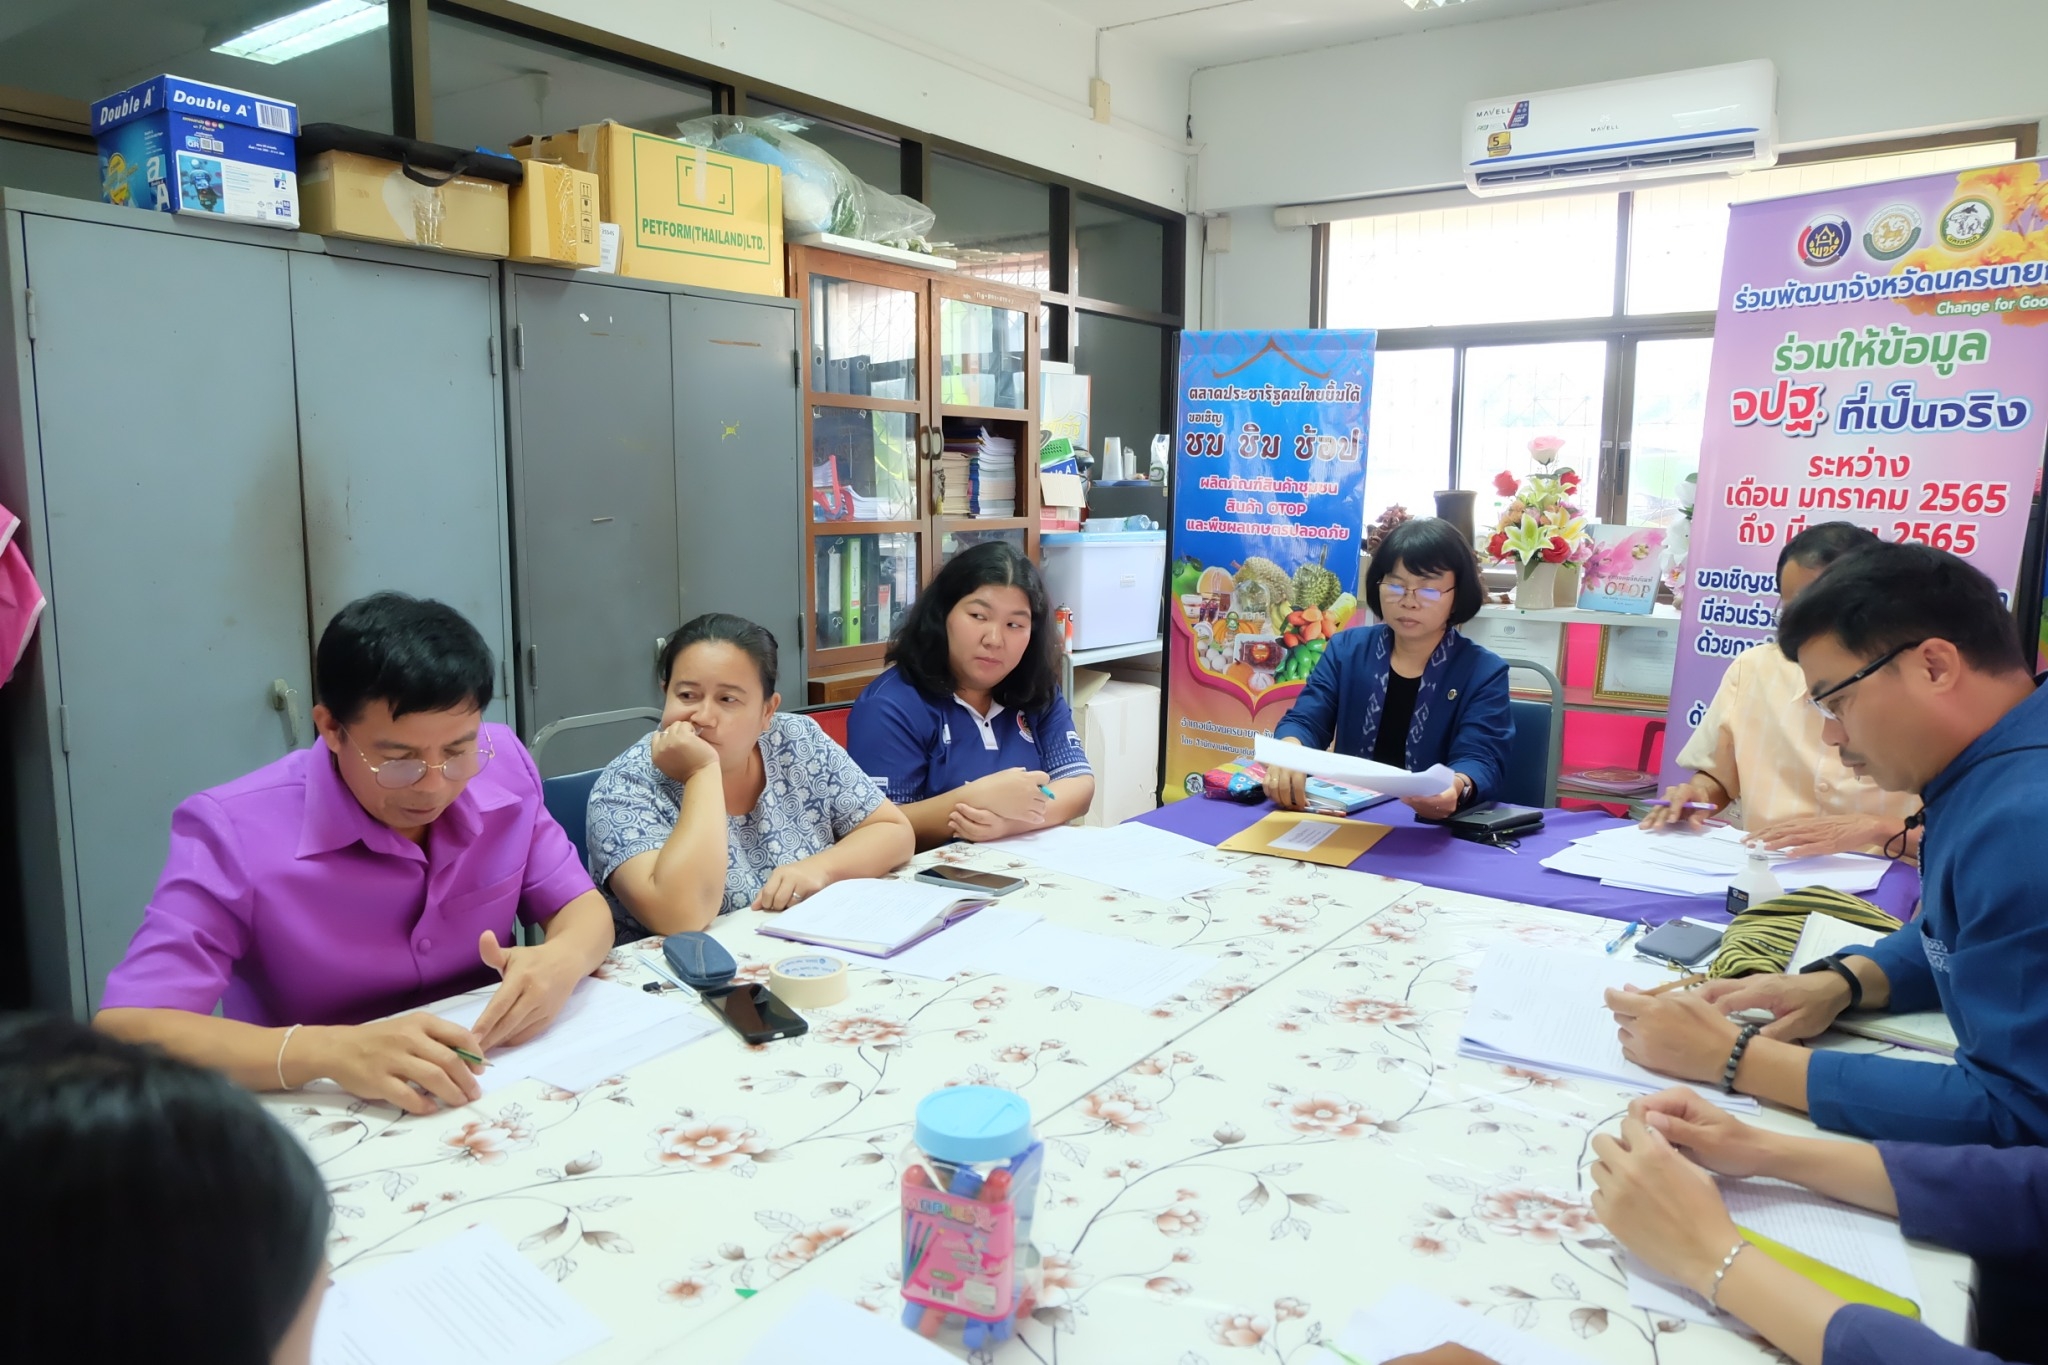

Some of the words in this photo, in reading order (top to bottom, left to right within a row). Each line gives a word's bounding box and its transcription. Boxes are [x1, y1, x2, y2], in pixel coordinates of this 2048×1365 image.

[100, 95, 140, 125] Double
[173, 90, 231, 113] Double
[1476, 108, 1511, 117] MAVELL
[1590, 124, 1619, 132] MAVELL
[1492, 136, 1500, 146] 5
[642, 217, 766, 250] PETFORM(THAILAND)LTD.
[1735, 262, 2048, 310] ร่วมพัฒนาจังหวัดนครนาย
[1936, 301, 1990, 315] Change
[1995, 297, 2015, 311] for
[1775, 326, 1987, 376] ร่วมให้ข้อมูล
[1189, 381, 1361, 405] ตลาดประชารัฐคนไทยยิ้มได้
[1732, 380, 1824, 432] จปฐ.
[1839, 385, 2028, 429] ที่เป็นจริง
[1188, 411, 1222, 425] ขอเชิญ
[1187, 432, 1224, 456] ชม
[1239, 424, 1280, 458] ชิม
[1296, 426, 1360, 460] ช้อป
[1808, 447, 1910, 478] ระหว่าง
[1201, 475, 1338, 495] ผลิตภัณฑ์สินค้าชุมชน
[1726, 477, 1788, 508] เดือน
[1799, 485, 1908, 511] มกราคม
[1919, 483, 2007, 513] 2565
[1226, 499, 1262, 513] สินค้า
[1267, 503, 1307, 515] OTOP
[1187, 518, 1349, 540] และพืชผลเกษตรปลอดภัย
[1738, 514, 1774, 545] ถึง
[1893, 522, 1976, 554] 2565
[1605, 581, 1651, 598] OTOP
